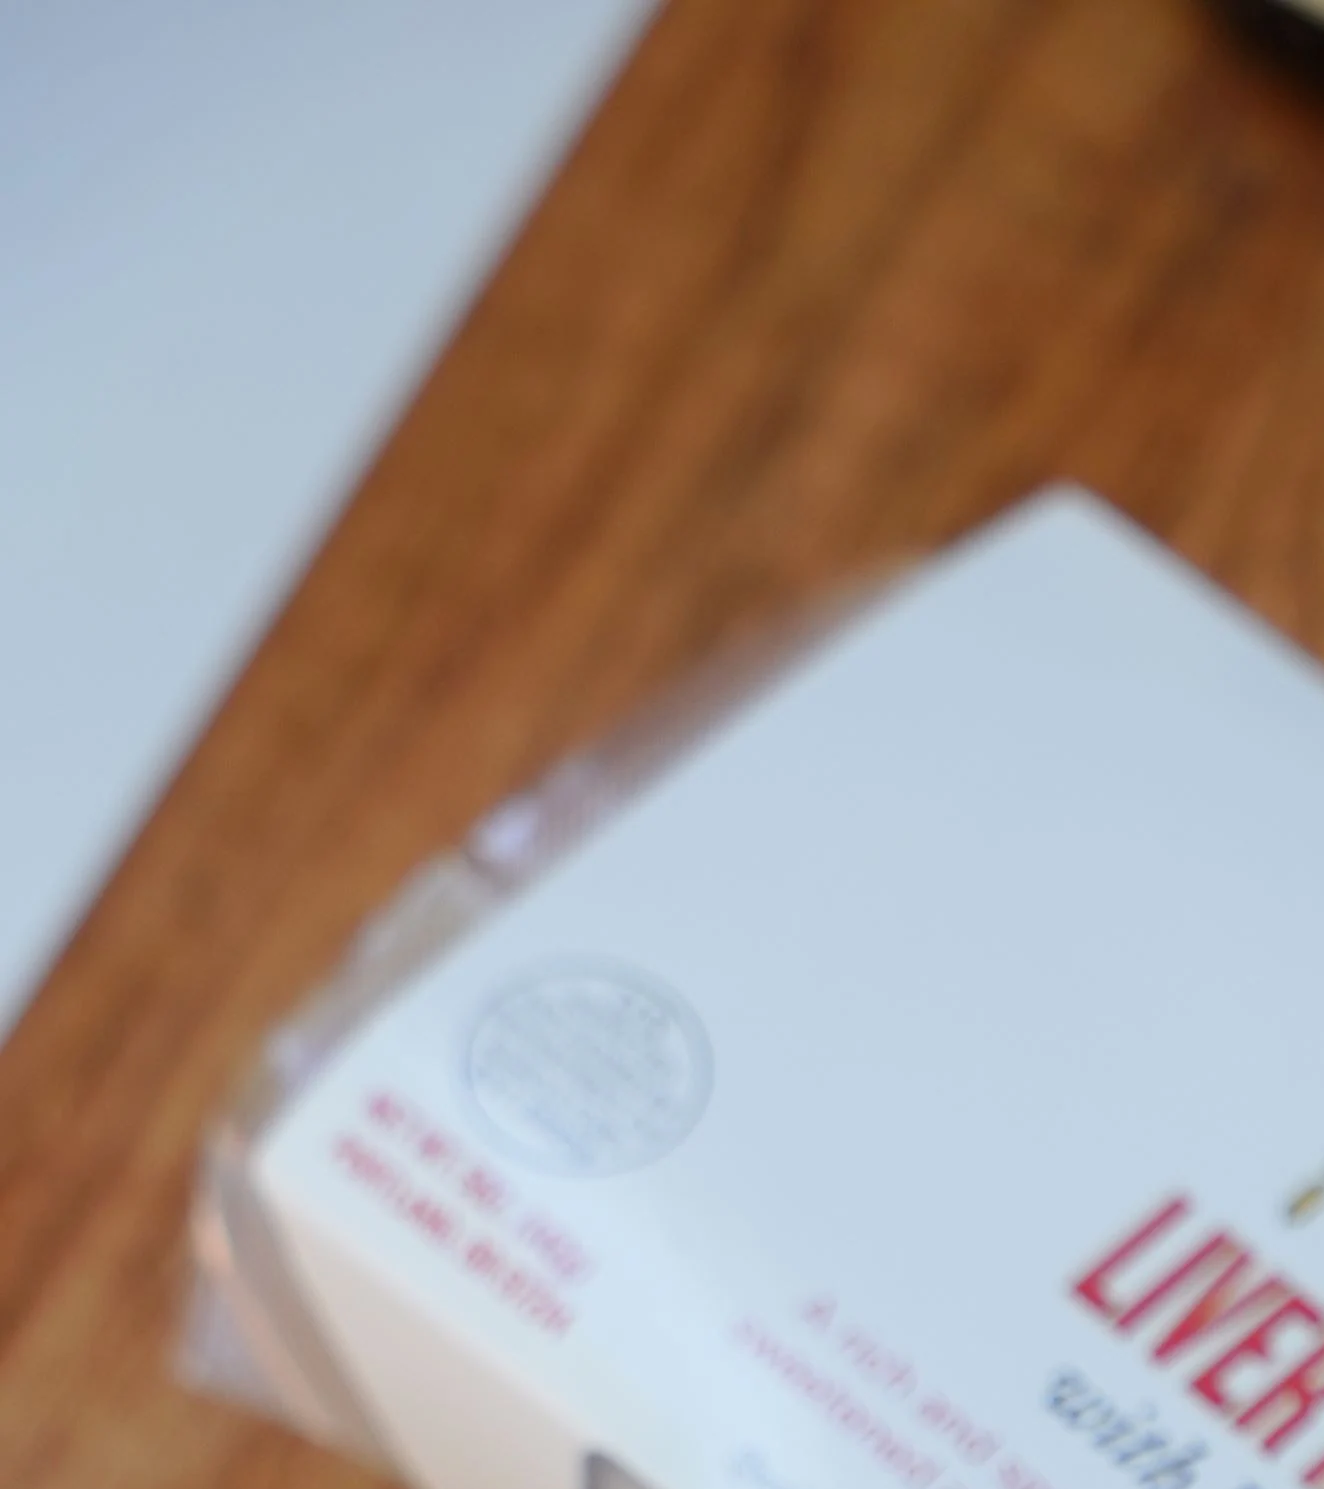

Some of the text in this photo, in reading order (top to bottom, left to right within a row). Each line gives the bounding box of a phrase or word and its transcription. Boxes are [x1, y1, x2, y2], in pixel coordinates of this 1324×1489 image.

[727, 1325, 943, 1489] sweetened
[802, 1300, 836, 1330] A
[842, 1332, 928, 1397] rich
[918, 1398, 1000, 1462] and
